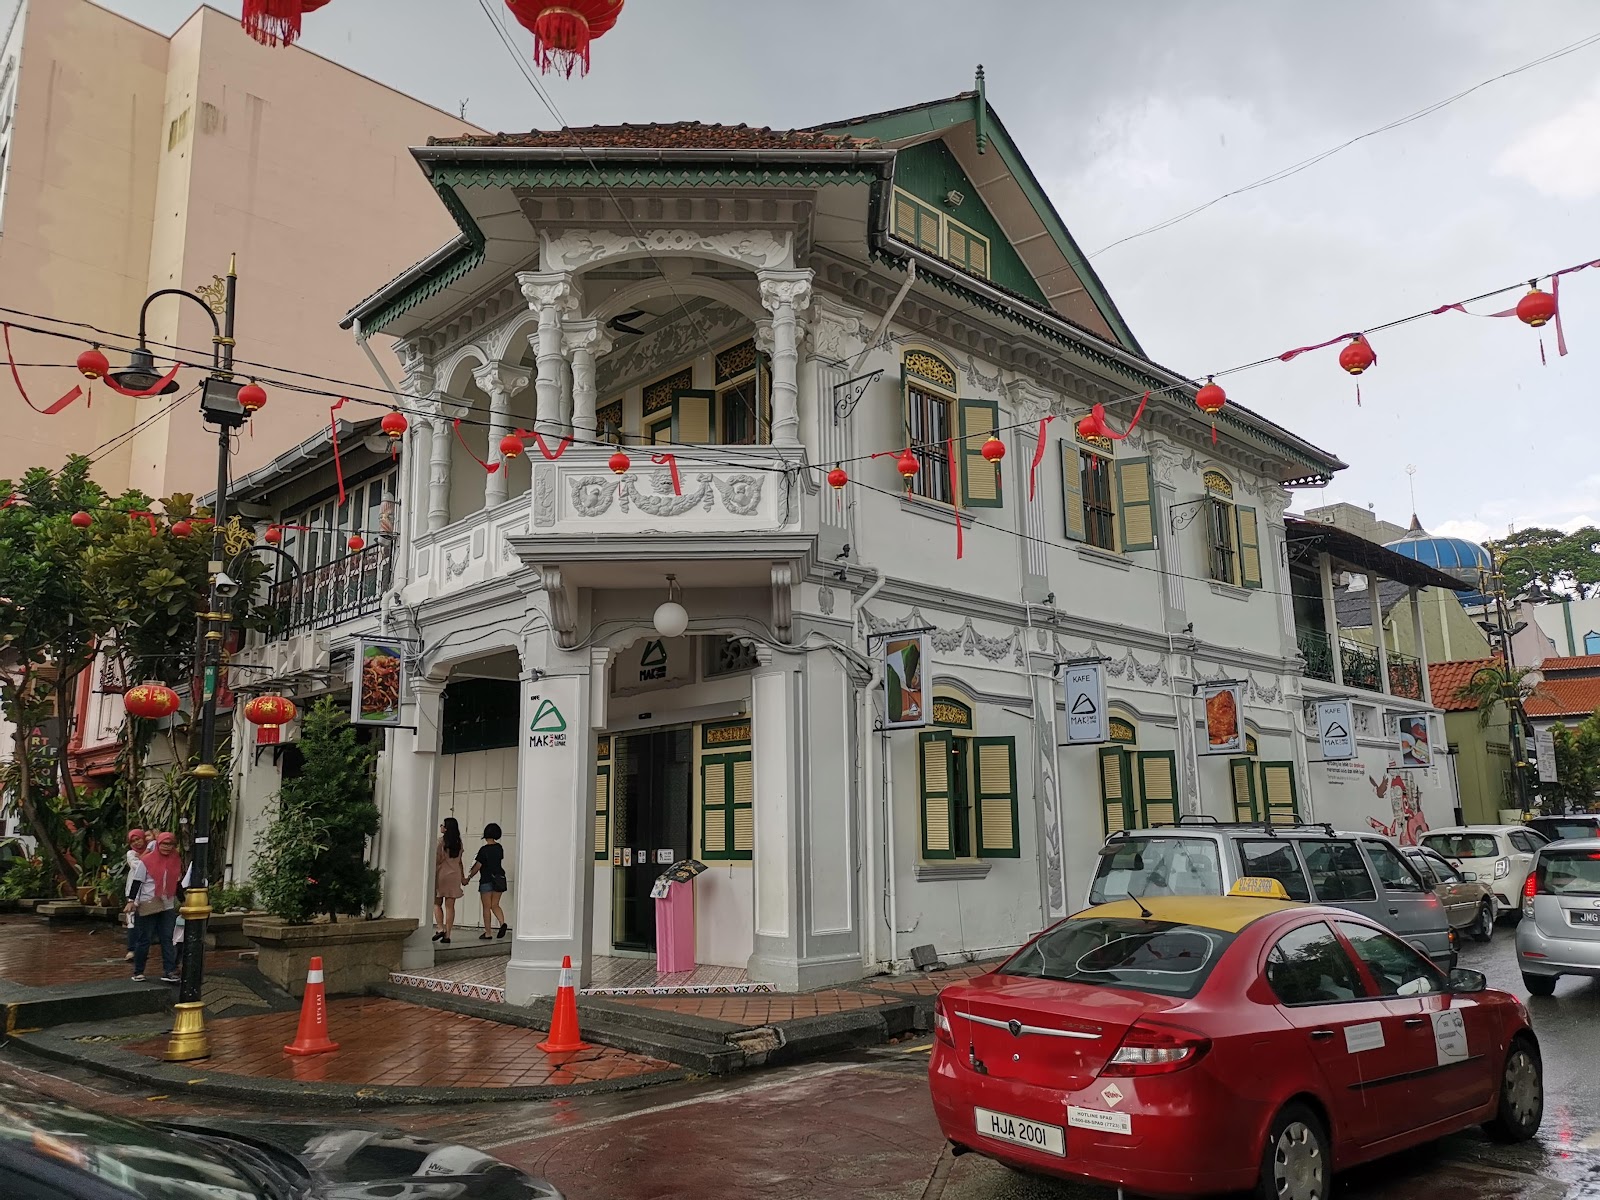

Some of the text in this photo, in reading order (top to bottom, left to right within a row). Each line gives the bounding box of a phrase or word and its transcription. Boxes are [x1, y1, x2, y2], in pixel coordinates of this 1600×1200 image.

[1073, 675, 1090, 683] KAFE
[1071, 716, 1087, 725] MAK
[529, 735, 549, 748] MAK
[991, 1116, 1047, 1146] HJA 2001
